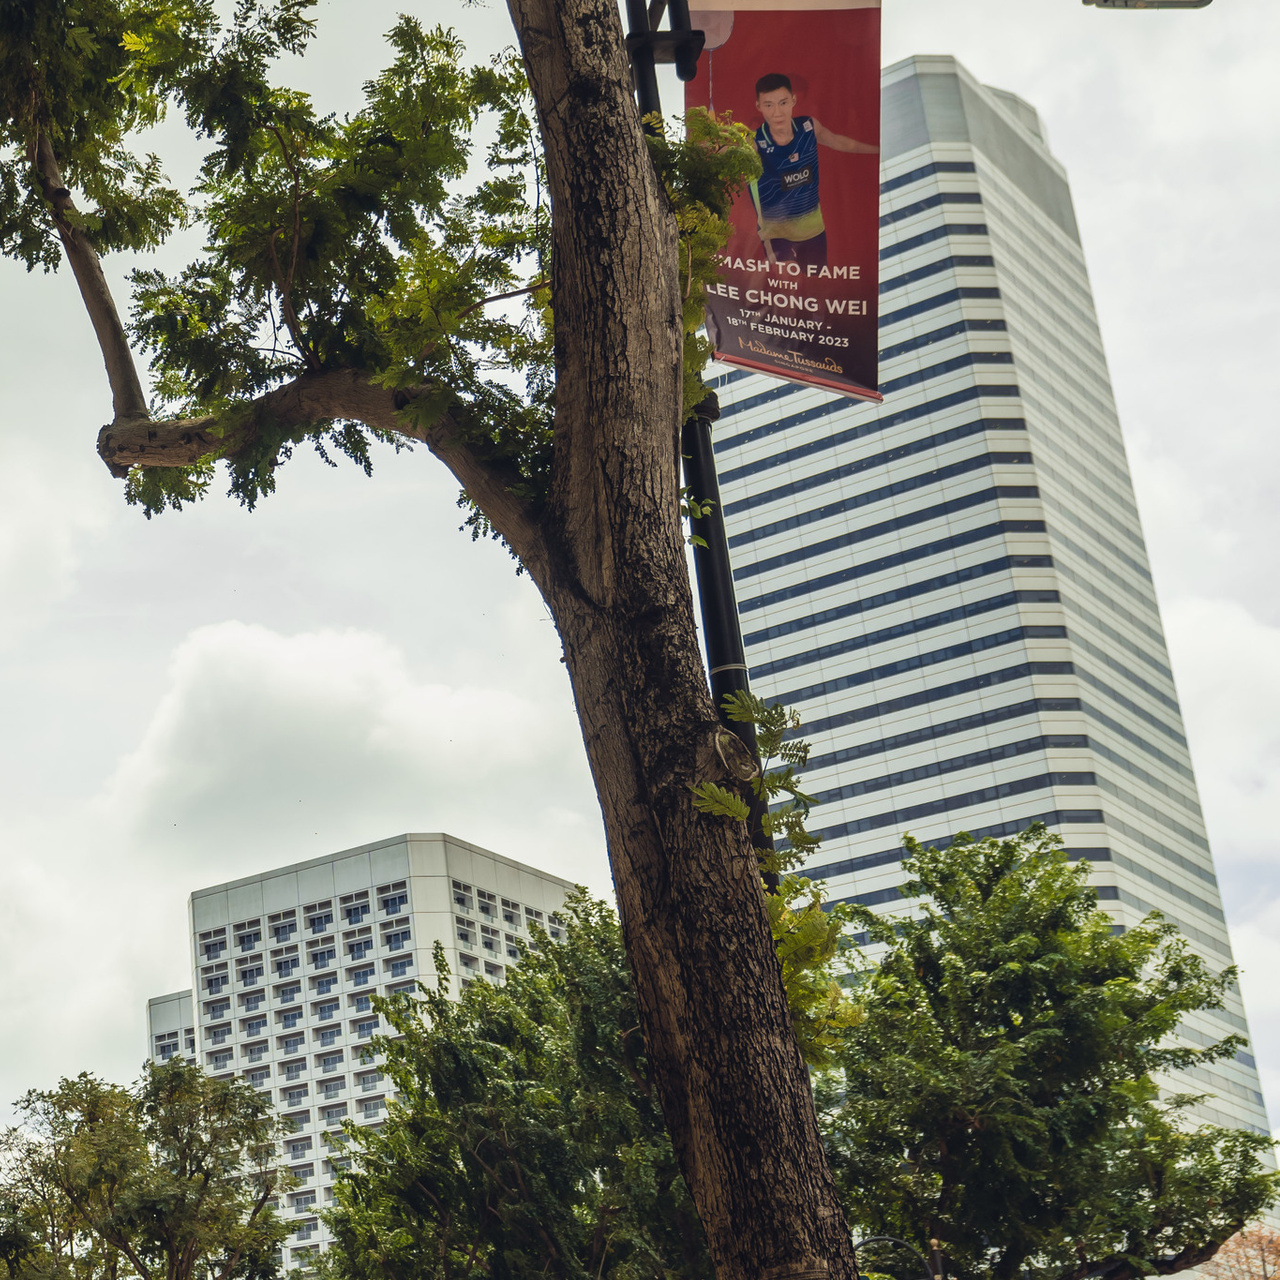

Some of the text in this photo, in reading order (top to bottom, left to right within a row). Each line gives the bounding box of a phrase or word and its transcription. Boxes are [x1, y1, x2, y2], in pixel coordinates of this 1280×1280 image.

[784, 169, 810, 184] WOLO
[775, 262, 801, 276] TO
[806, 265, 861, 280] FAME
[767, 278, 798, 291] WITH
[706, 282, 868, 316] LEE CHONG WEI
[739, 308, 761, 318] 17TH
[764, 313, 823, 331] JANUARY
[726, 316, 849, 348] 18TH FEBRUARY 2023
[738, 336, 843, 374] Madame Tussauds
